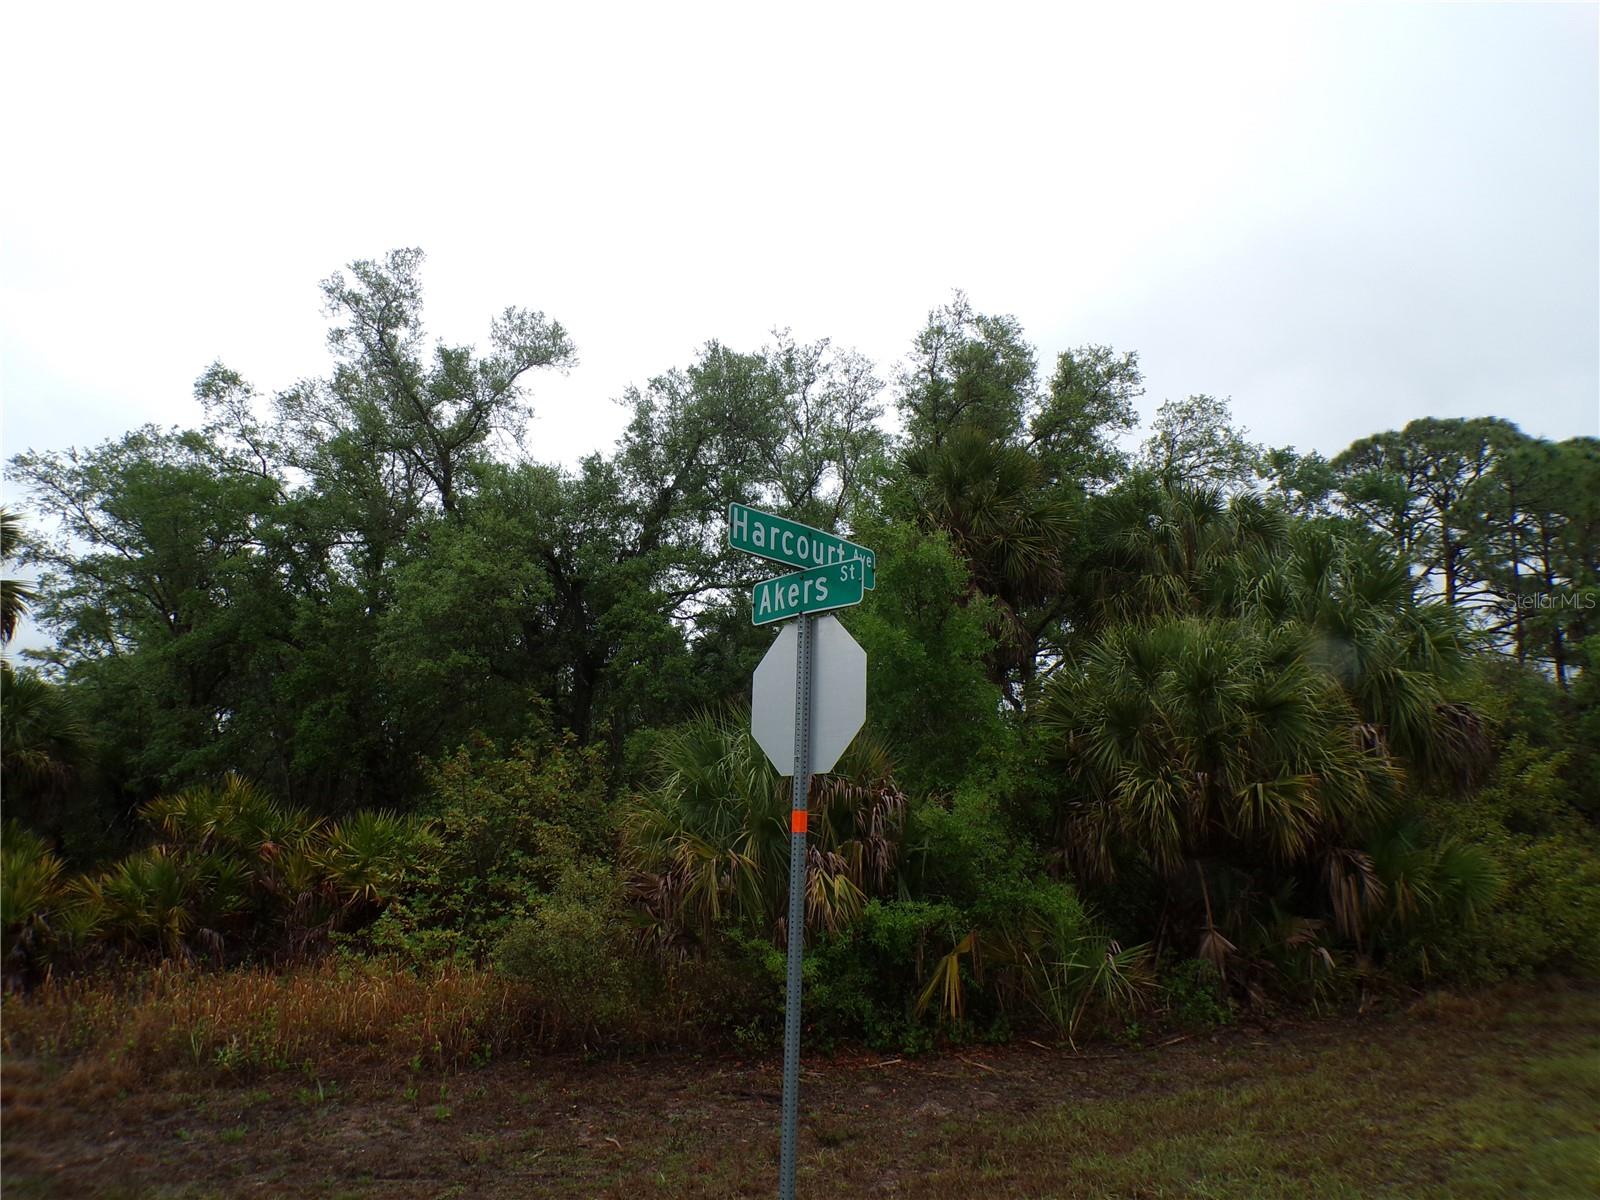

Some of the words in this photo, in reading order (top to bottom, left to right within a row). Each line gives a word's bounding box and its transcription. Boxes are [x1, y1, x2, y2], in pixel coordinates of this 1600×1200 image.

[732, 507, 845, 565] Harcourt
[759, 576, 828, 615] Akers
[840, 564, 855, 582] St
